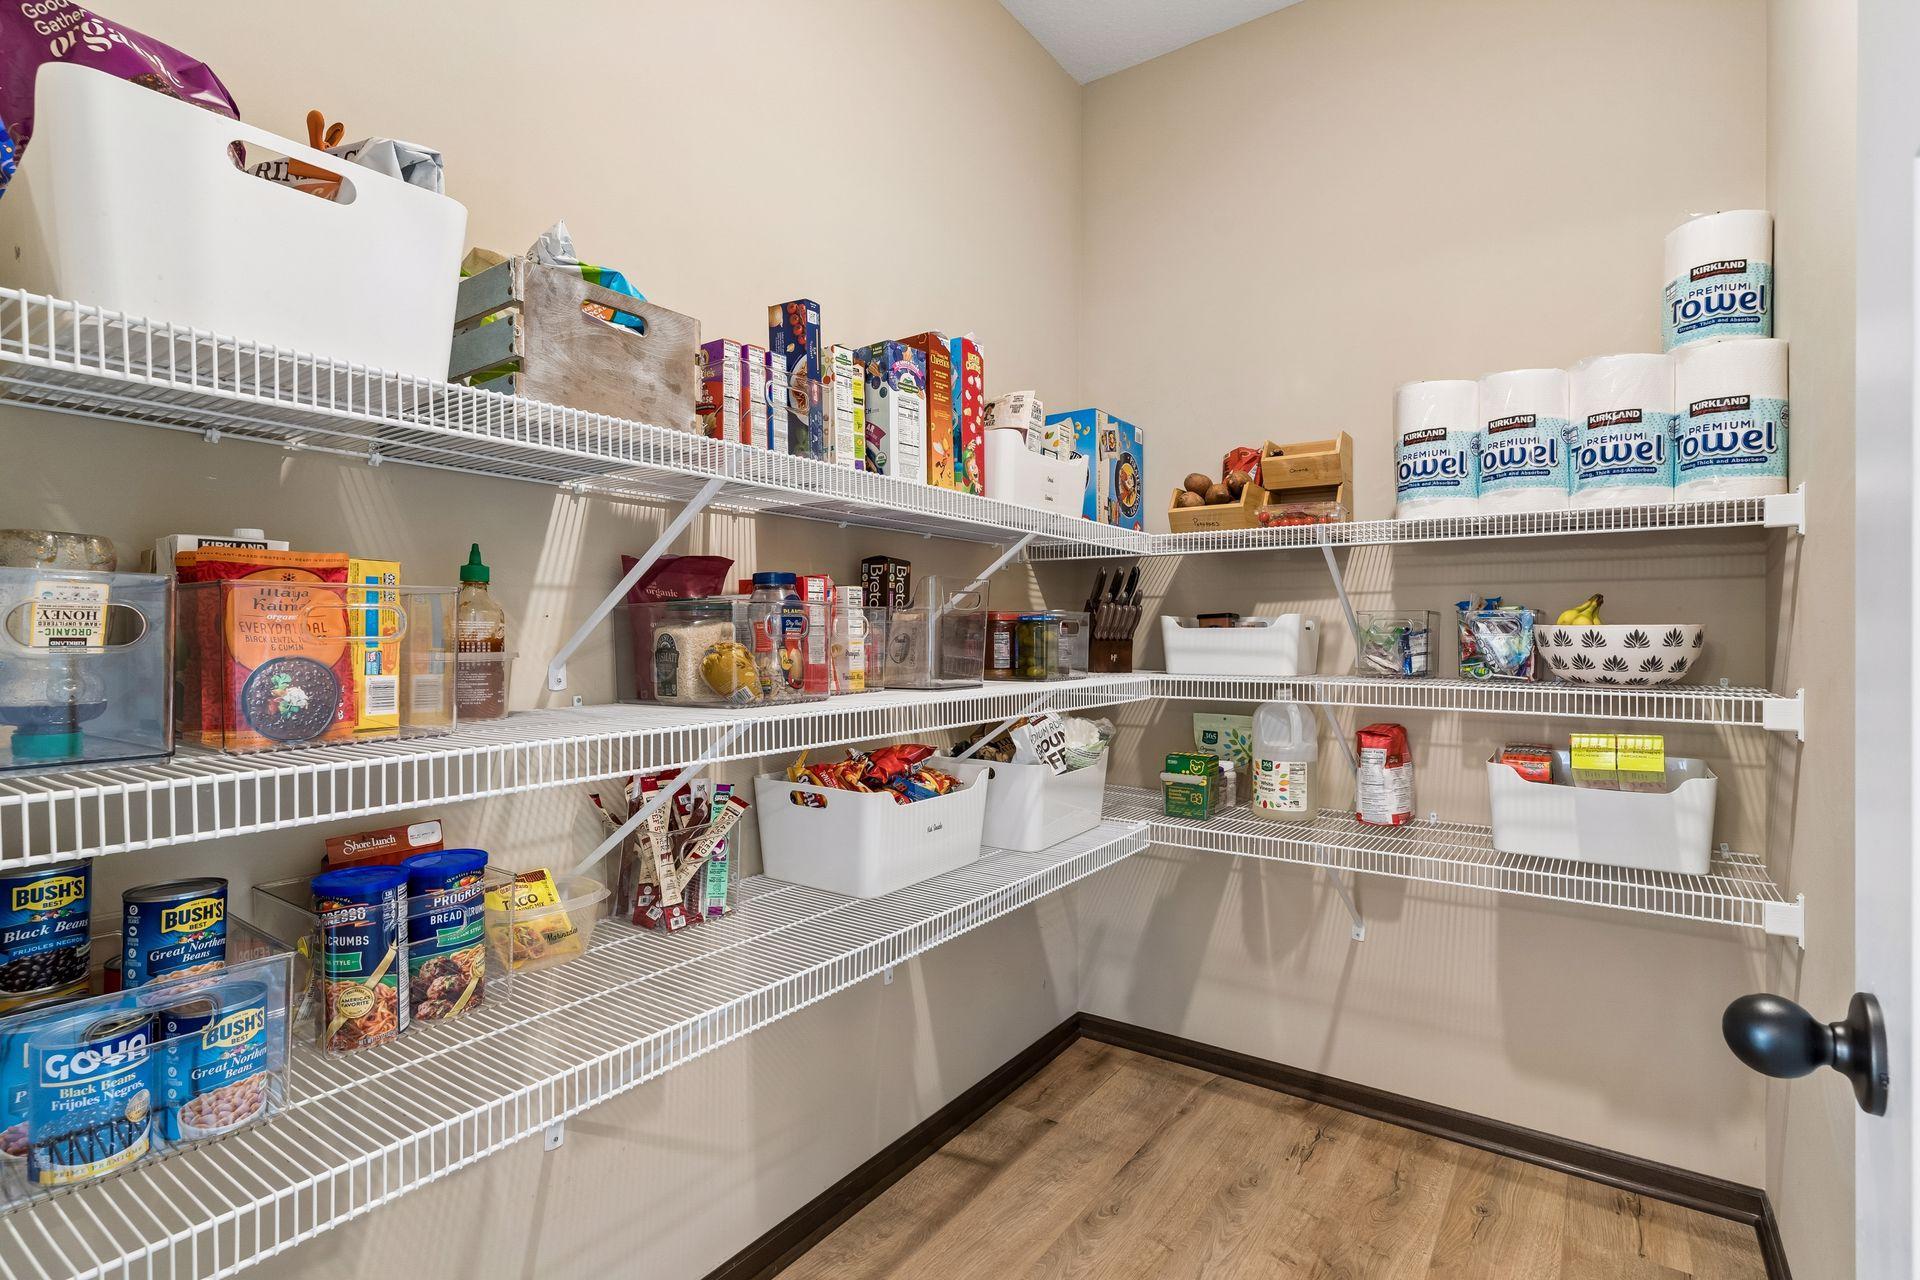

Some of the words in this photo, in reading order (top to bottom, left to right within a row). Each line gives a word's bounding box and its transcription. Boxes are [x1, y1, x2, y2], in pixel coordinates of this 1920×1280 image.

[34, 8, 87, 35] Gather
[1692, 260, 1745, 276] KIRKLAND
[1688, 282, 1747, 299] PREMIUM
[1671, 285, 1765, 324] Towel
[1692, 397, 1749, 412] KIRKLAND
[1489, 415, 1535, 430] KIRKLAND
[1588, 410, 1641, 424] KIRKLAND
[1404, 428, 1446, 441] KIRKLAND
[1689, 421, 1750, 435] PREMIUM
[1487, 437, 1536, 449] PREMIUM
[1586, 432, 1643, 446] PREMIUM
[1675, 422, 1775, 462] Towel
[1402, 449, 1447, 462] PREMIUM
[1571, 435, 1663, 470] Towel
[1731, 456, 1766, 464] Absorbent
[1397, 451, 1465, 479] owel
[201, 539, 266, 550] KIRKLAND
[646, 589, 679, 599] organic
[869, 564, 884, 608] Breto
[39, 610, 98, 621] HONEY
[44, 628, 92, 636] ORGANIC
[343, 839, 371, 855] Shore
[371, 834, 397, 847] Lunch
[16, 880, 84, 908] BUSH'S
[42, 900, 64, 909] BEST
[164, 902, 223, 930] BUSH'S
[430, 910, 462, 925] BREAD
[3, 924, 50, 944] Black
[54, 918, 89, 933] Beans
[189, 921, 208, 930] BEST
[12, 942, 54, 957] FRIJOLES
[56, 937, 83, 947] NEGROS
[150, 945, 185, 962] Great
[182, 950, 211, 963] Beans
[206, 1011, 264, 1047] BUSH'S
[231, 1034, 249, 1045] BEST
[45, 1033, 147, 1081] GOYA
[191, 1063, 227, 1081] Great
[225, 1063, 253, 1080] Beans
[59, 1084, 97, 1099] Black
[101, 1072, 136, 1091] Beans
[51, 1096, 100, 1112] Frijoles
